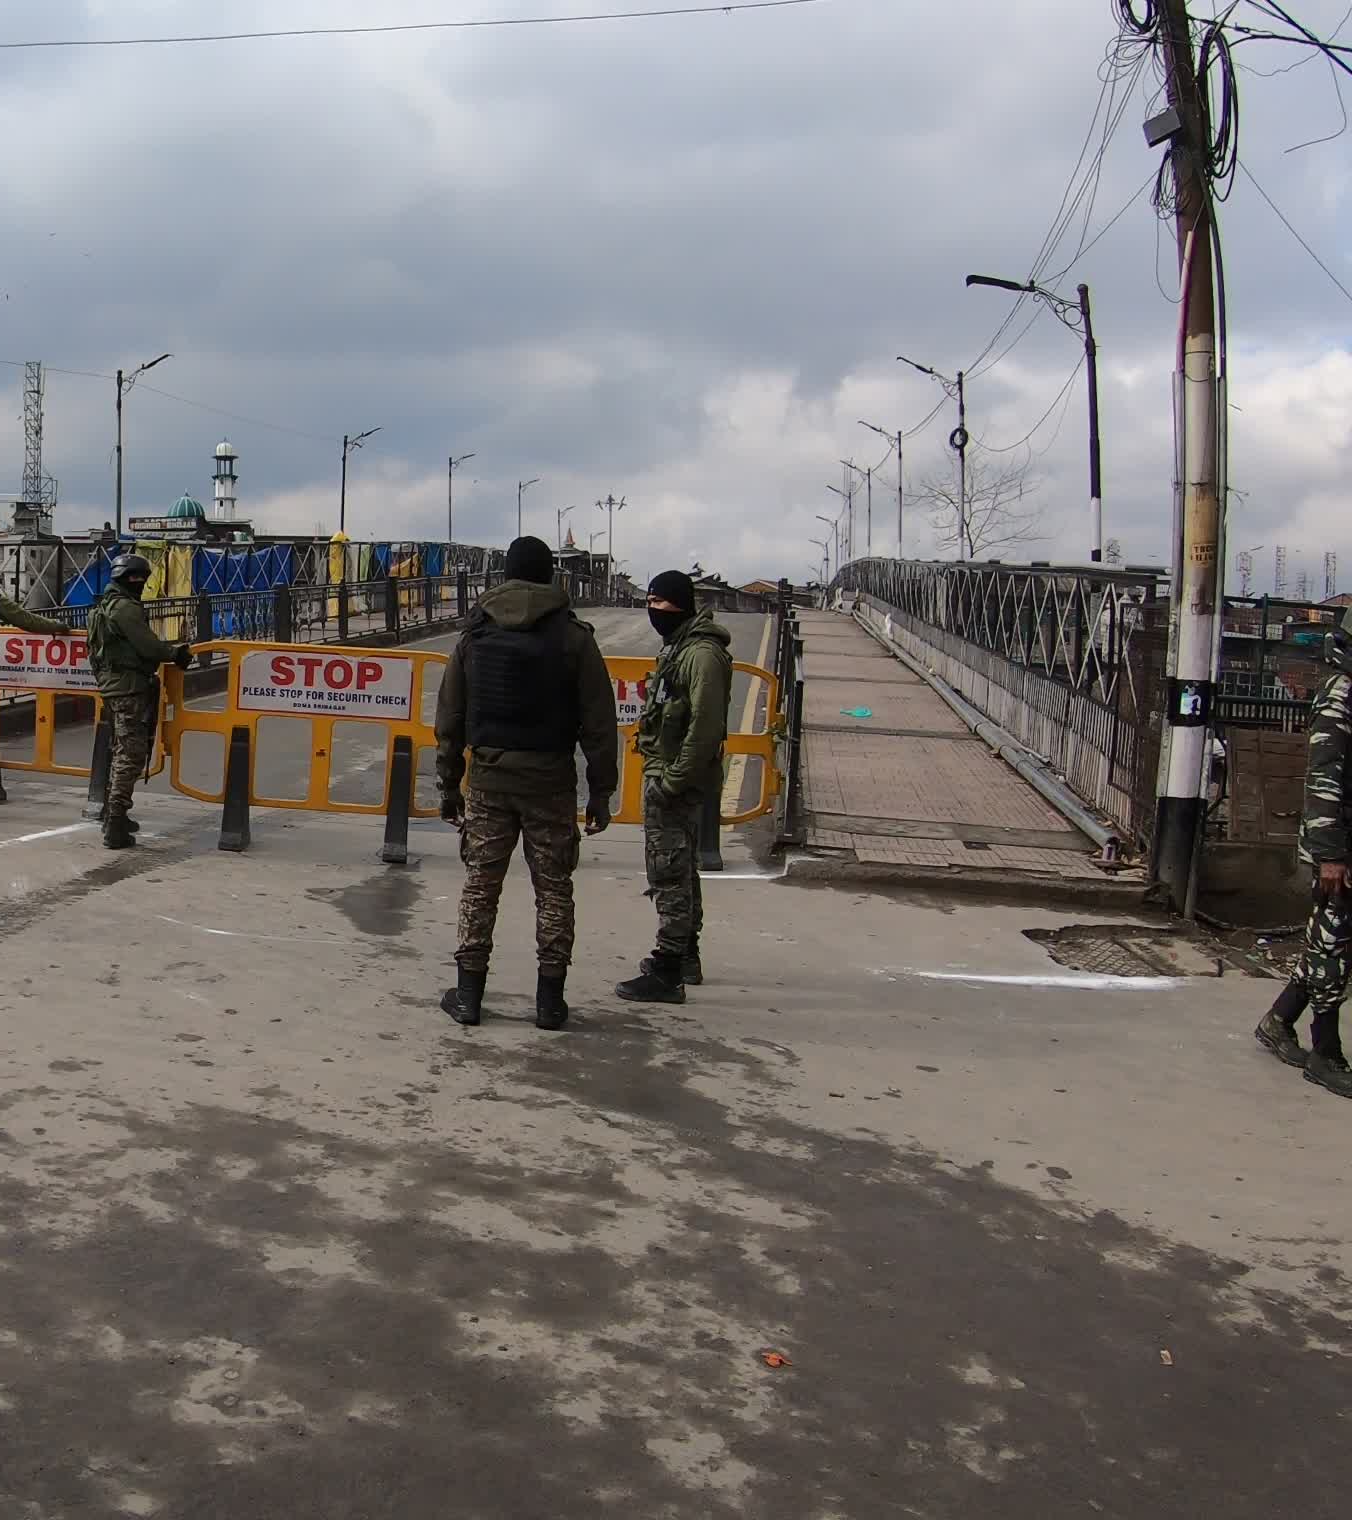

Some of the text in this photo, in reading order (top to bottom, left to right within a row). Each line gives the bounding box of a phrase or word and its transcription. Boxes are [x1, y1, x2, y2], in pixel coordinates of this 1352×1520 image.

[4, 637, 88, 667] STOP
[26, 666, 45, 674] POLICE
[270, 655, 383, 691] STOP
[242, 686, 408, 706] PLEASE STOP FOR SECURITY CHECK
[619, 704, 637, 714] FOR
